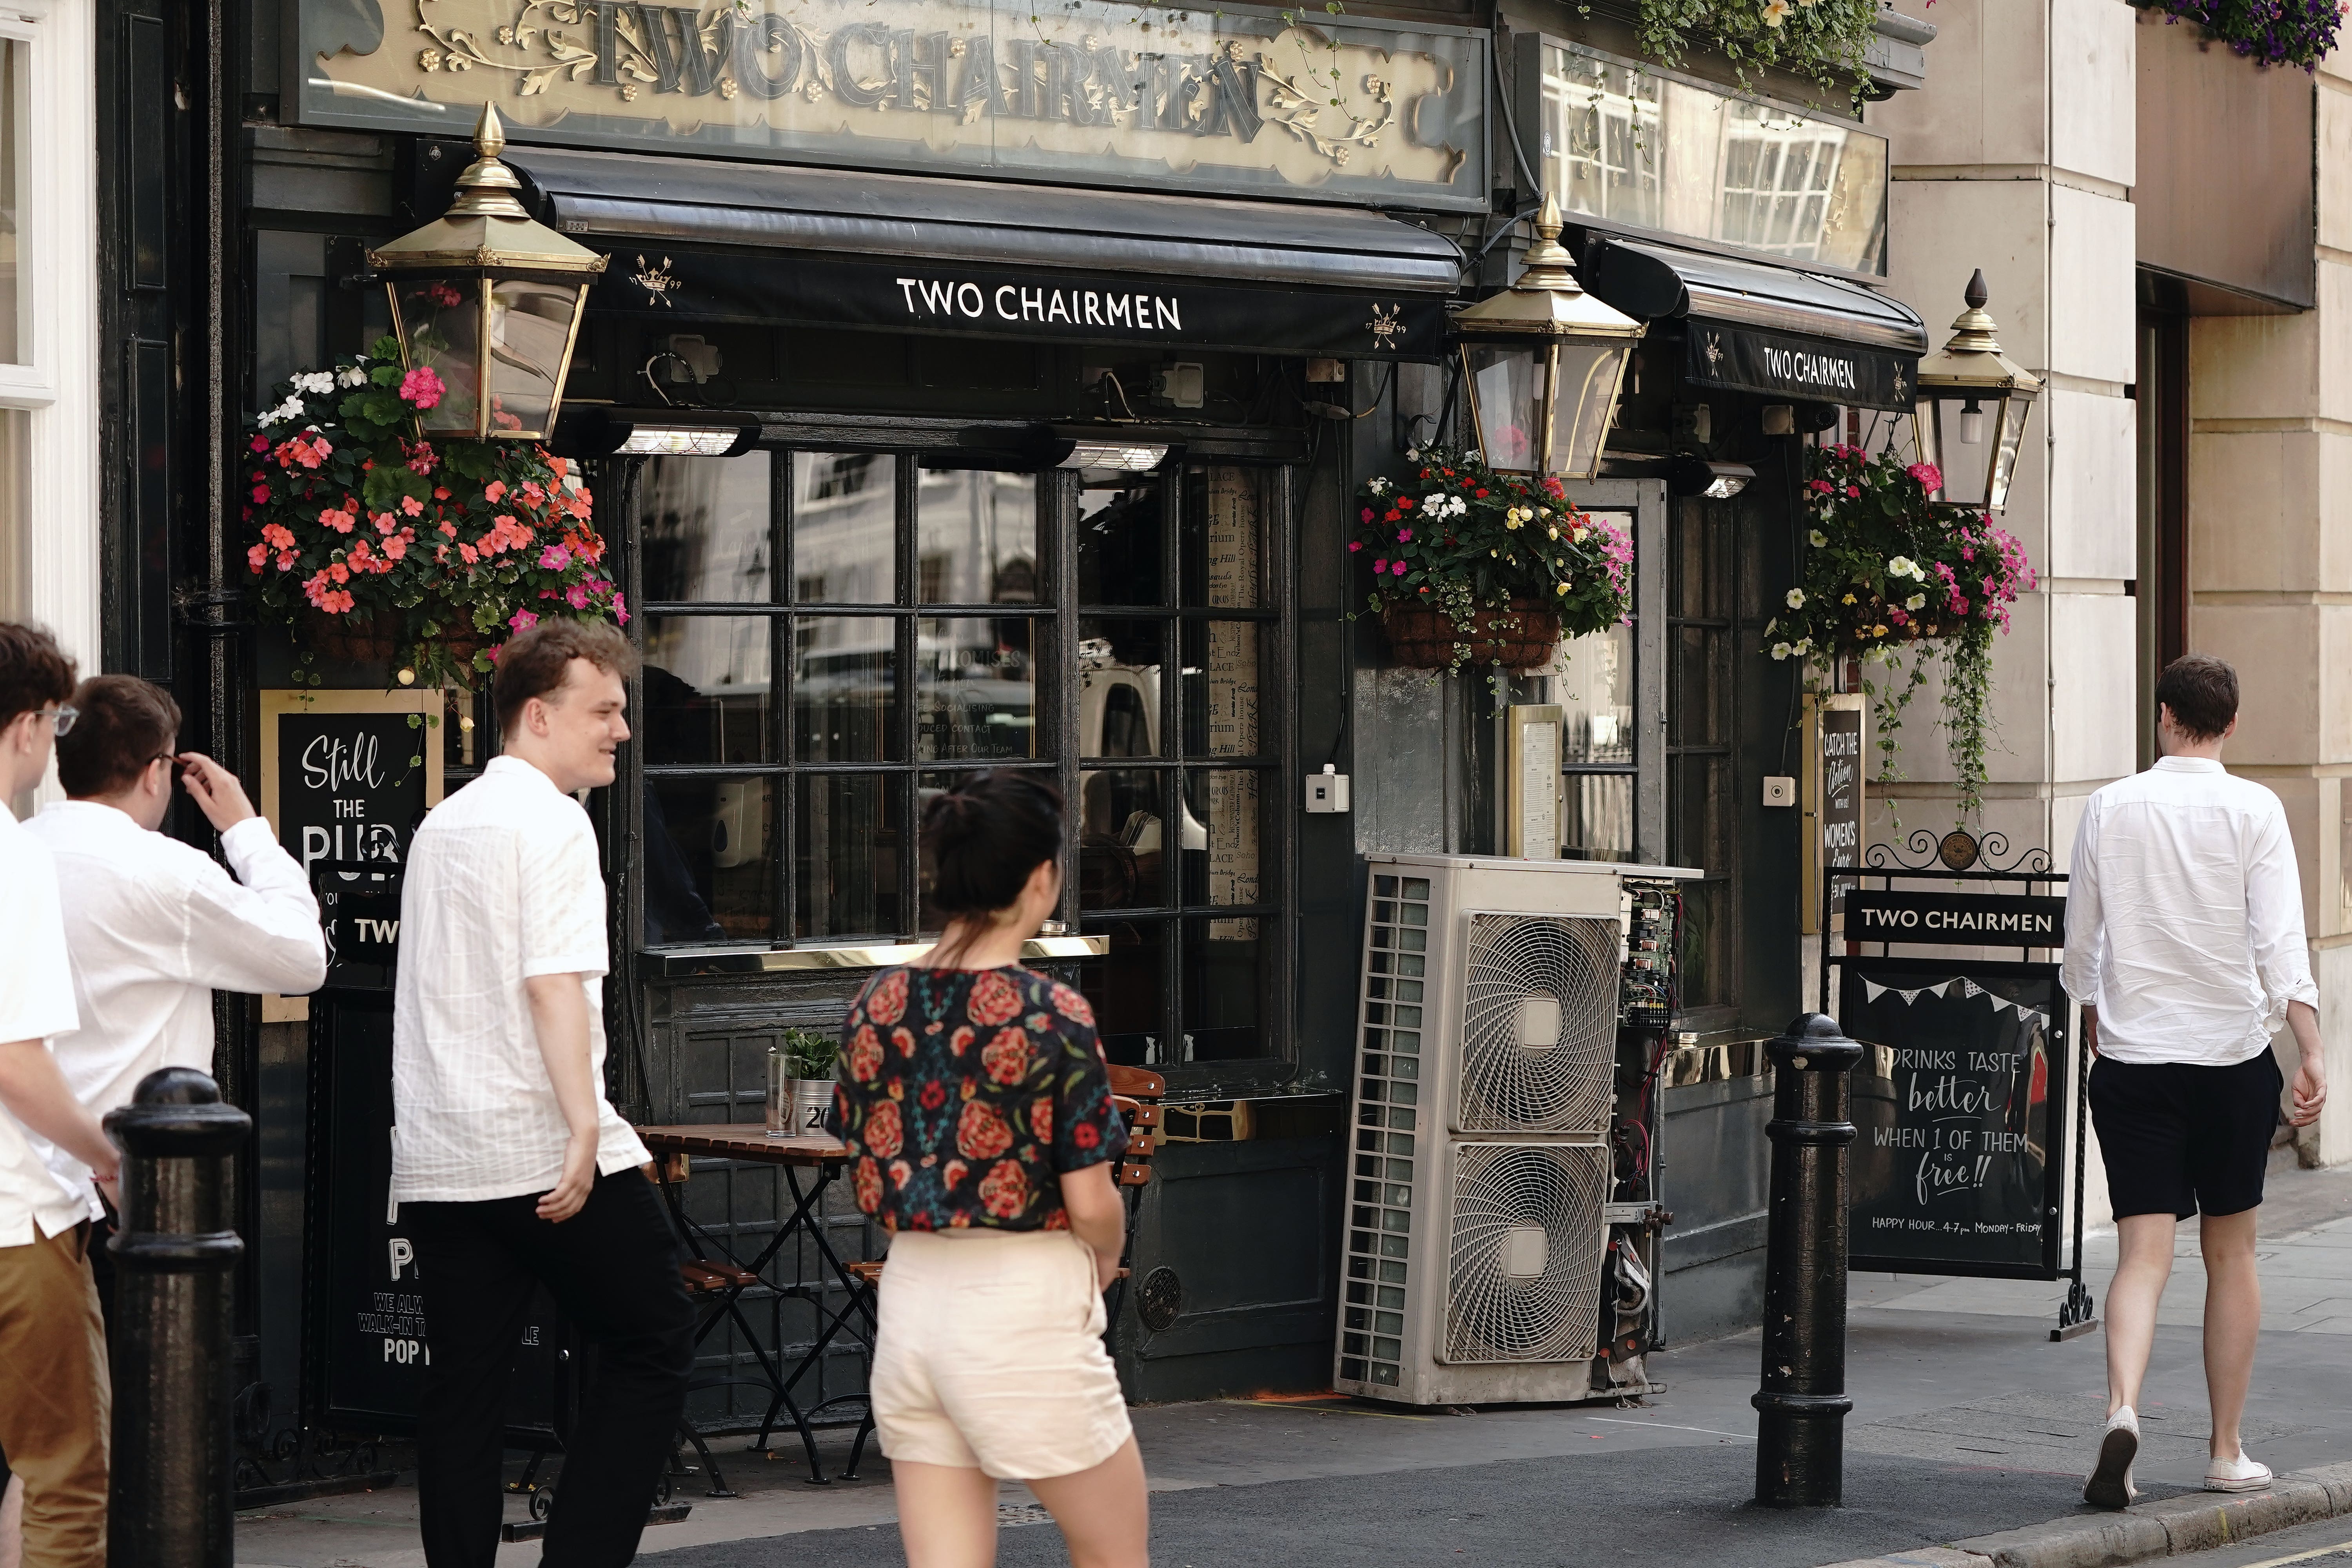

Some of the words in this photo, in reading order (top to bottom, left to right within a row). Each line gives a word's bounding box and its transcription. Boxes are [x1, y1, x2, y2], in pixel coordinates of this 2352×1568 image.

[573, 0, 803, 100] TWO
[832, 20, 1264, 143] CHAIRMEN
[897, 278, 984, 318] TWO
[995, 285, 1181, 330] CHAIRMEN
[1764, 347, 1791, 379] TWO
[1794, 352, 1855, 389] CHAIRMEN
[1220, 554, 1236, 563] Hill
[1212, 595, 1229, 604] CIRCUS
[1217, 646, 1236, 658] End
[951, 724, 992, 733] CONTACT
[1219, 744, 1235, 753] Hill
[1824, 733, 1845, 757] CATCH
[1846, 732, 1858, 755] THE
[302, 731, 385, 792] Still
[1828, 759, 1853, 795] Action
[1212, 786, 1228, 795] CIRCUS
[333, 799, 365, 818] THE
[1216, 838, 1235, 849] End
[1824, 820, 1855, 848] WOMEN'S
[1236, 851, 1255, 859] Soho
[1861, 909, 1918, 927] TWO
[1925, 911, 2052, 932] CHAIRMEN
[1892, 1048, 1956, 1070] DRINKS
[1968, 1052, 2021, 1073] TASTE
[1909, 1072, 2001, 1113] better
[1875, 1127, 1925, 1147] WHEN
[1949, 1130, 1972, 1150] OF
[1982, 1131, 2027, 1152] THEM
[1944, 1153, 1952, 1161] IS
[1873, 1217, 1905, 1229] HAPPY
[374, 1292, 395, 1312] WE
[358, 1313, 413, 1335] WALK-IN
[384, 1338, 419, 1364] POP
